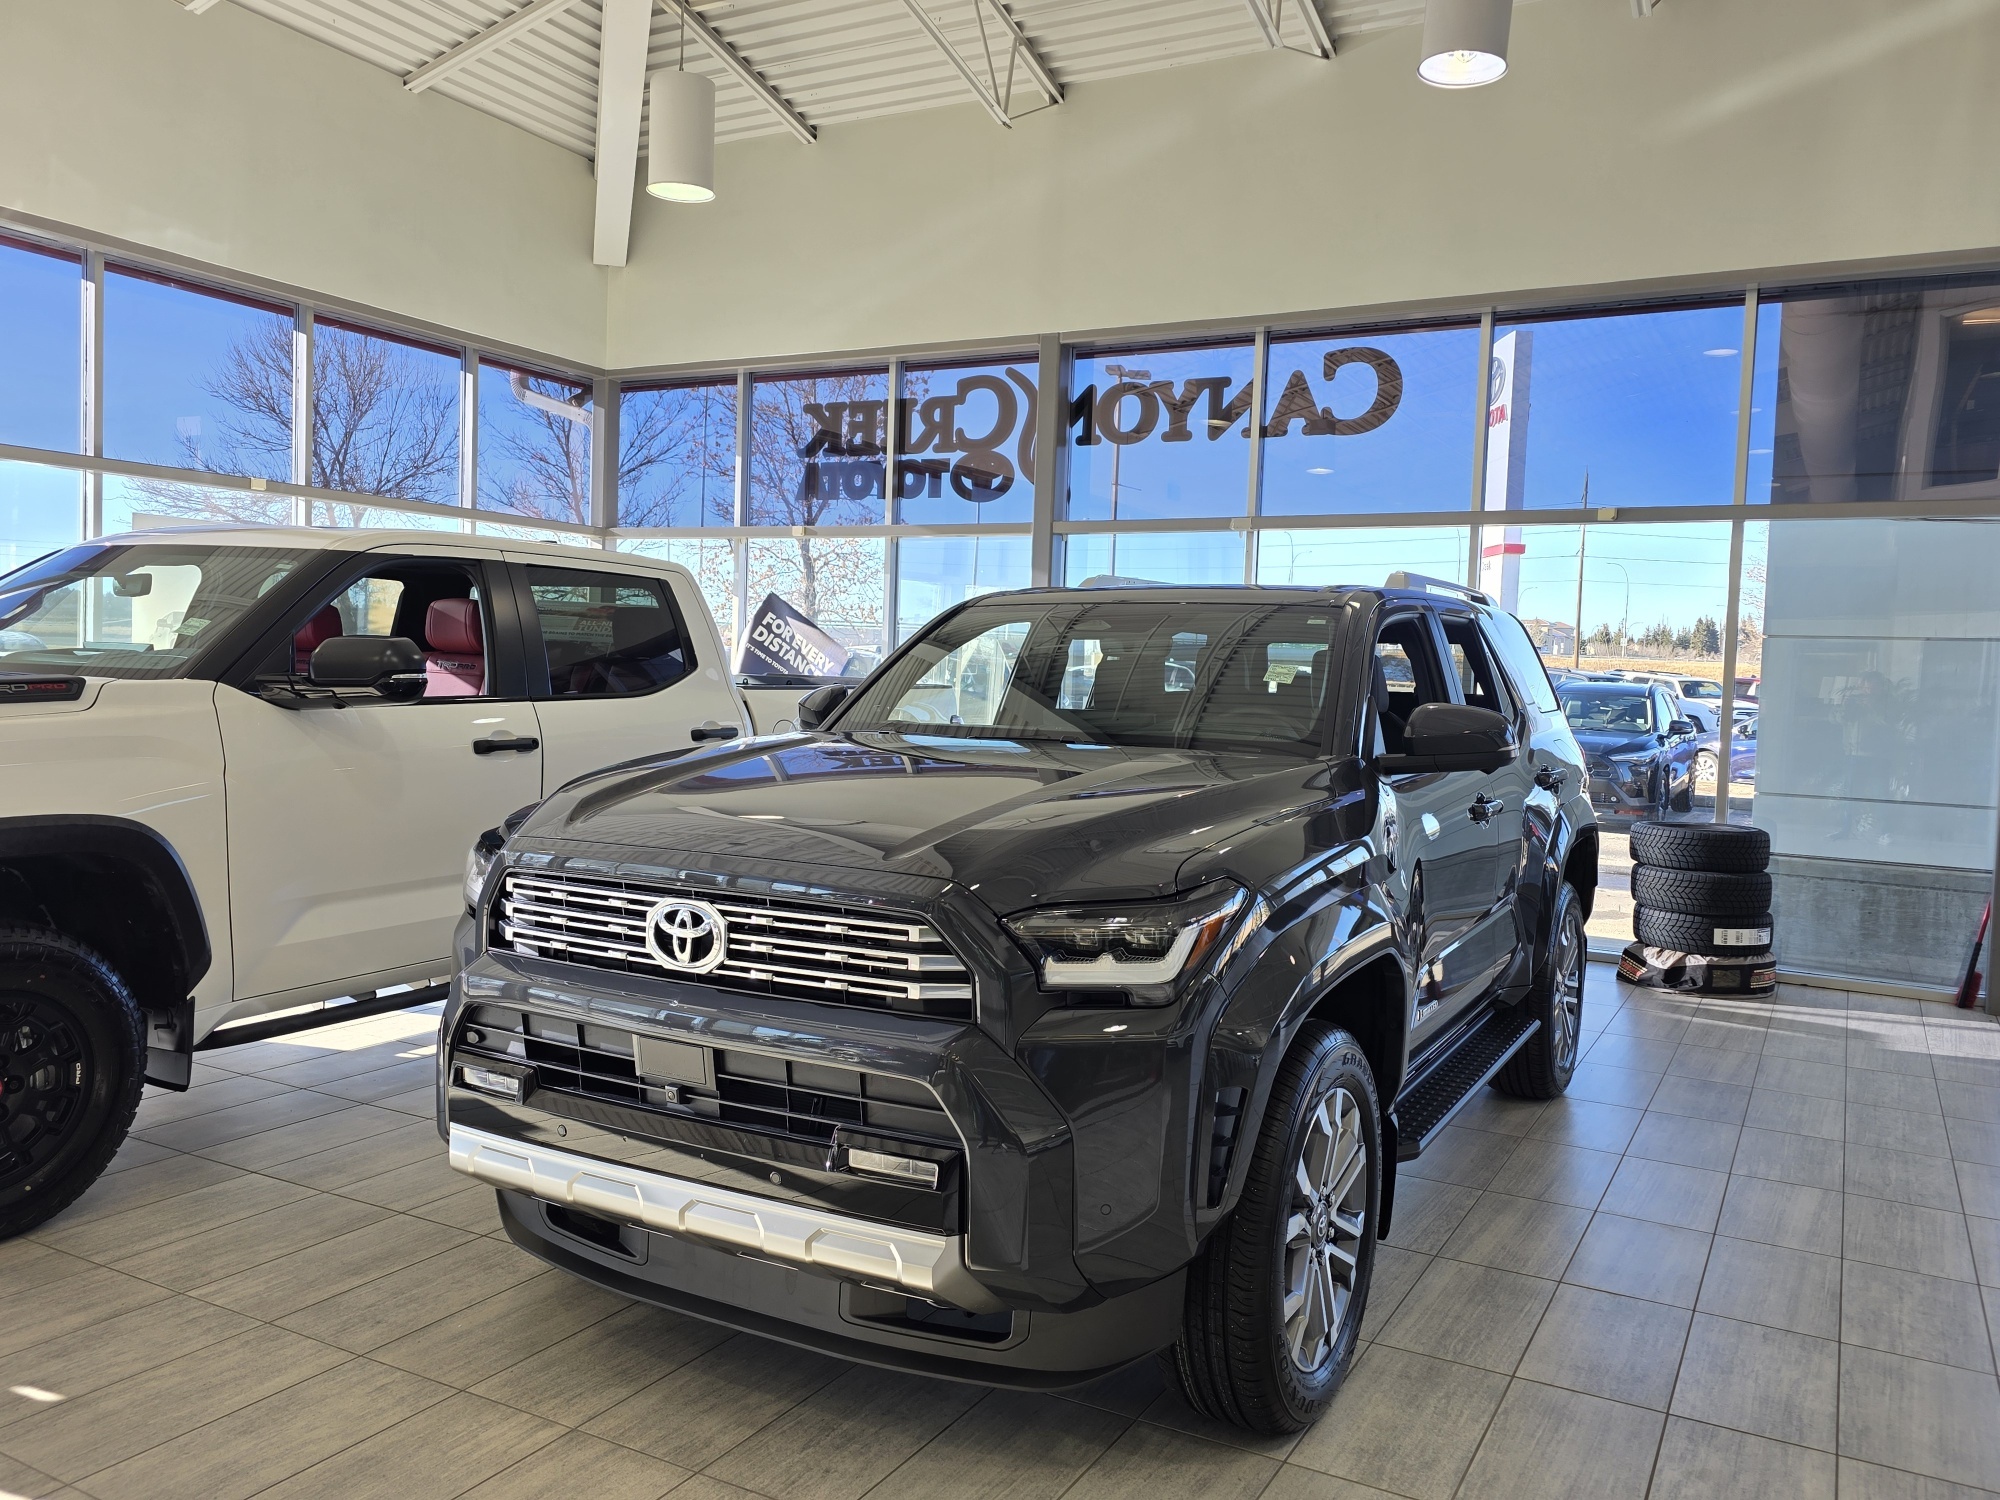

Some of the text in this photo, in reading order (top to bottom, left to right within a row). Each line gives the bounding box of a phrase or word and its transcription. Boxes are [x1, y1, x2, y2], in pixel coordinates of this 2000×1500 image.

[579, 624, 612, 633] TUND
[752, 625, 823, 676] DISTANC
[761, 611, 835, 674] FOR EVERY
[753, 648, 767, 660] TIME
[765, 655, 773, 664] TO
[771, 660, 789, 675] TOYOTA
[0, 683, 68, 694] RD PRO
